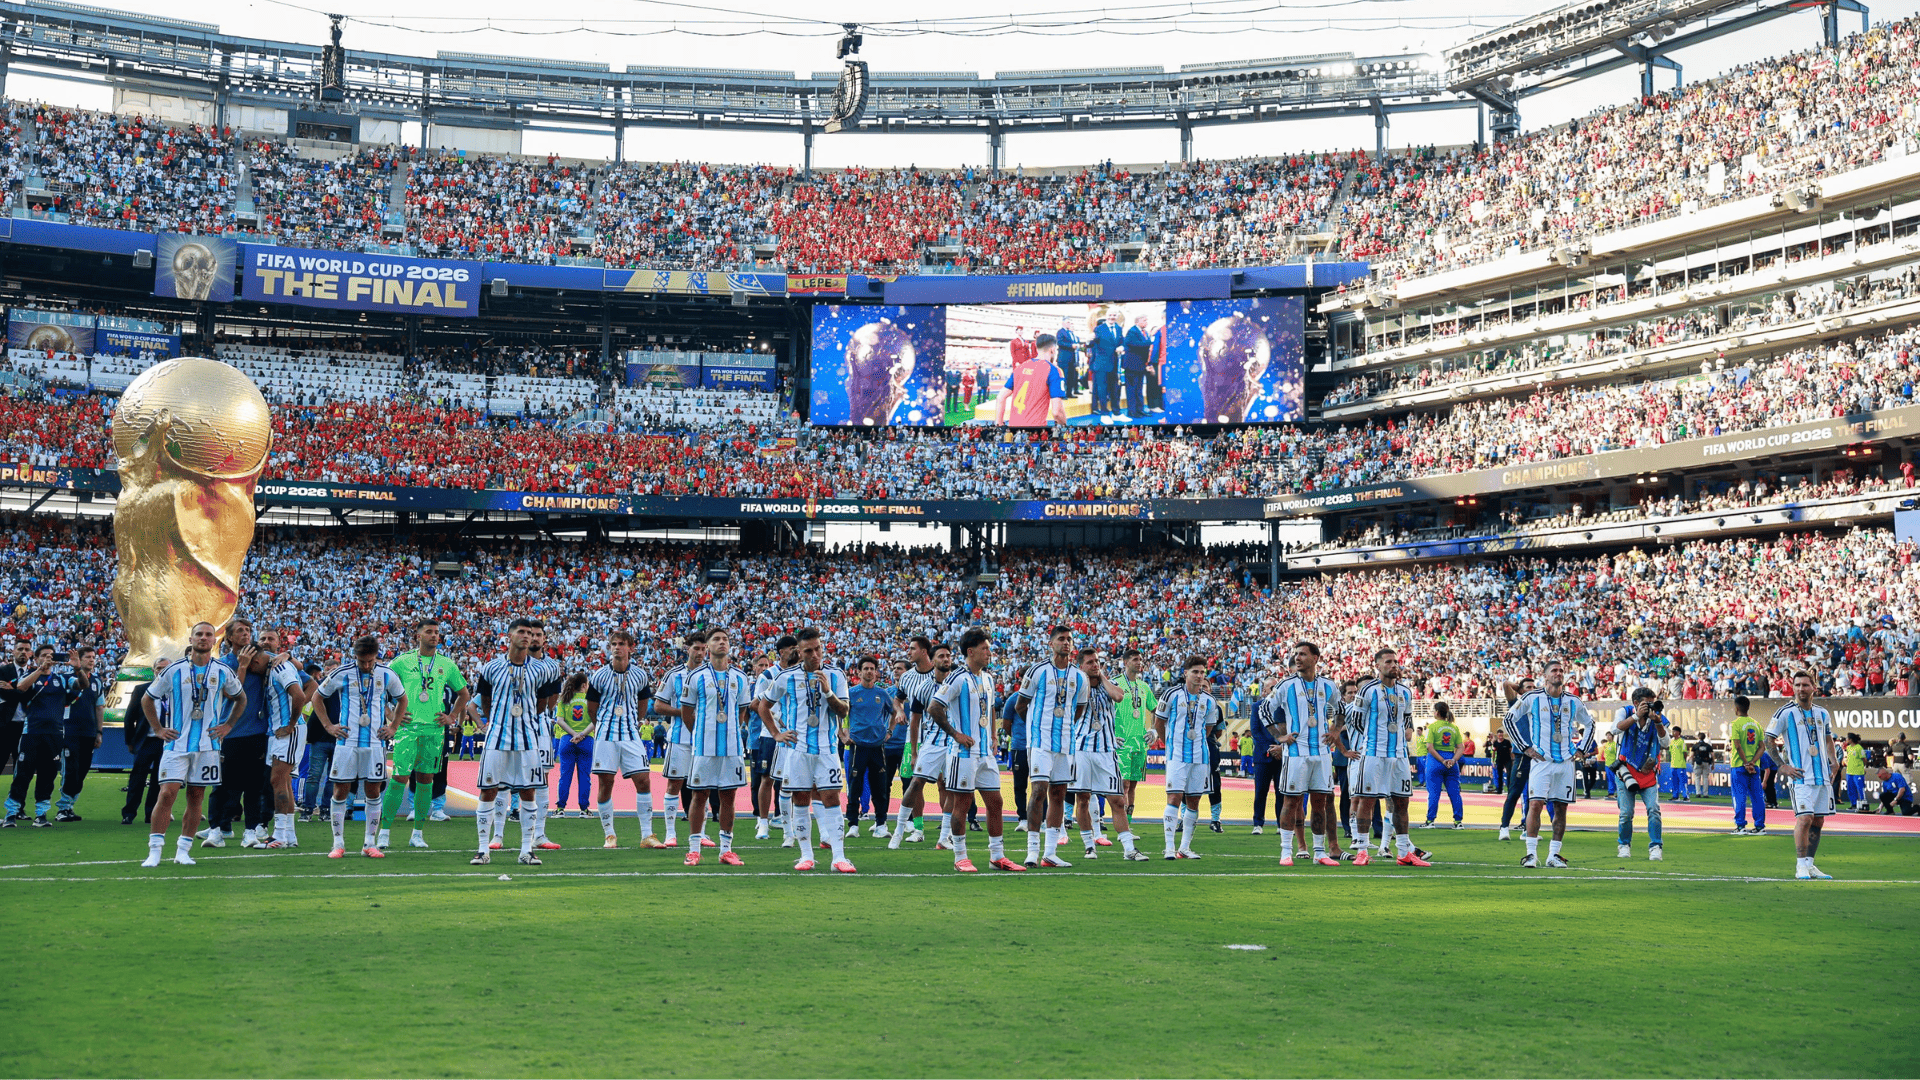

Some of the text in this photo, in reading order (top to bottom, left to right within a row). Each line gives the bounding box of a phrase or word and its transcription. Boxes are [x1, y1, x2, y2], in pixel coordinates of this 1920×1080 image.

[257, 253, 469, 282] FIFA WORLD CUP 2026
[256, 269, 468, 309] THE FINAL
[802, 278, 833, 288] LEPE
[1007, 281, 1103, 299] #FIFAWorldCup
[106, 338, 170, 351] THE FINAL
[710, 373, 766, 382] THE FINAL
[1013, 380, 1030, 415] 4
[1703, 415, 1908, 456] FIFA WORLD CUP 2026 THE FINAL
[1502, 461, 1588, 485] CHAMPIONS
[264, 486, 287, 495] CUP
[288, 486, 328, 497] 2026
[330, 488, 357, 498] THE
[358, 489, 397, 501] FINAL
[1266, 487, 1404, 512] FIFA WORLD CUP 2026 THE FINAL
[522, 495, 620, 510] CHAMPIONS
[740, 503, 924, 515] FIFA WORLD CUP 2026 THE FINAL
[1044, 503, 1141, 516] CHAMPIONS
[1833, 709, 1895, 729] WORLD
[202, 765, 219, 780] 20
[375, 762, 383, 777] 3
[530, 767, 541, 782] 14
[735, 766, 743, 781] 4
[1109, 776, 1117, 790] 11
[1401, 779, 1411, 792] 19
[1565, 785, 1572, 799] 7
